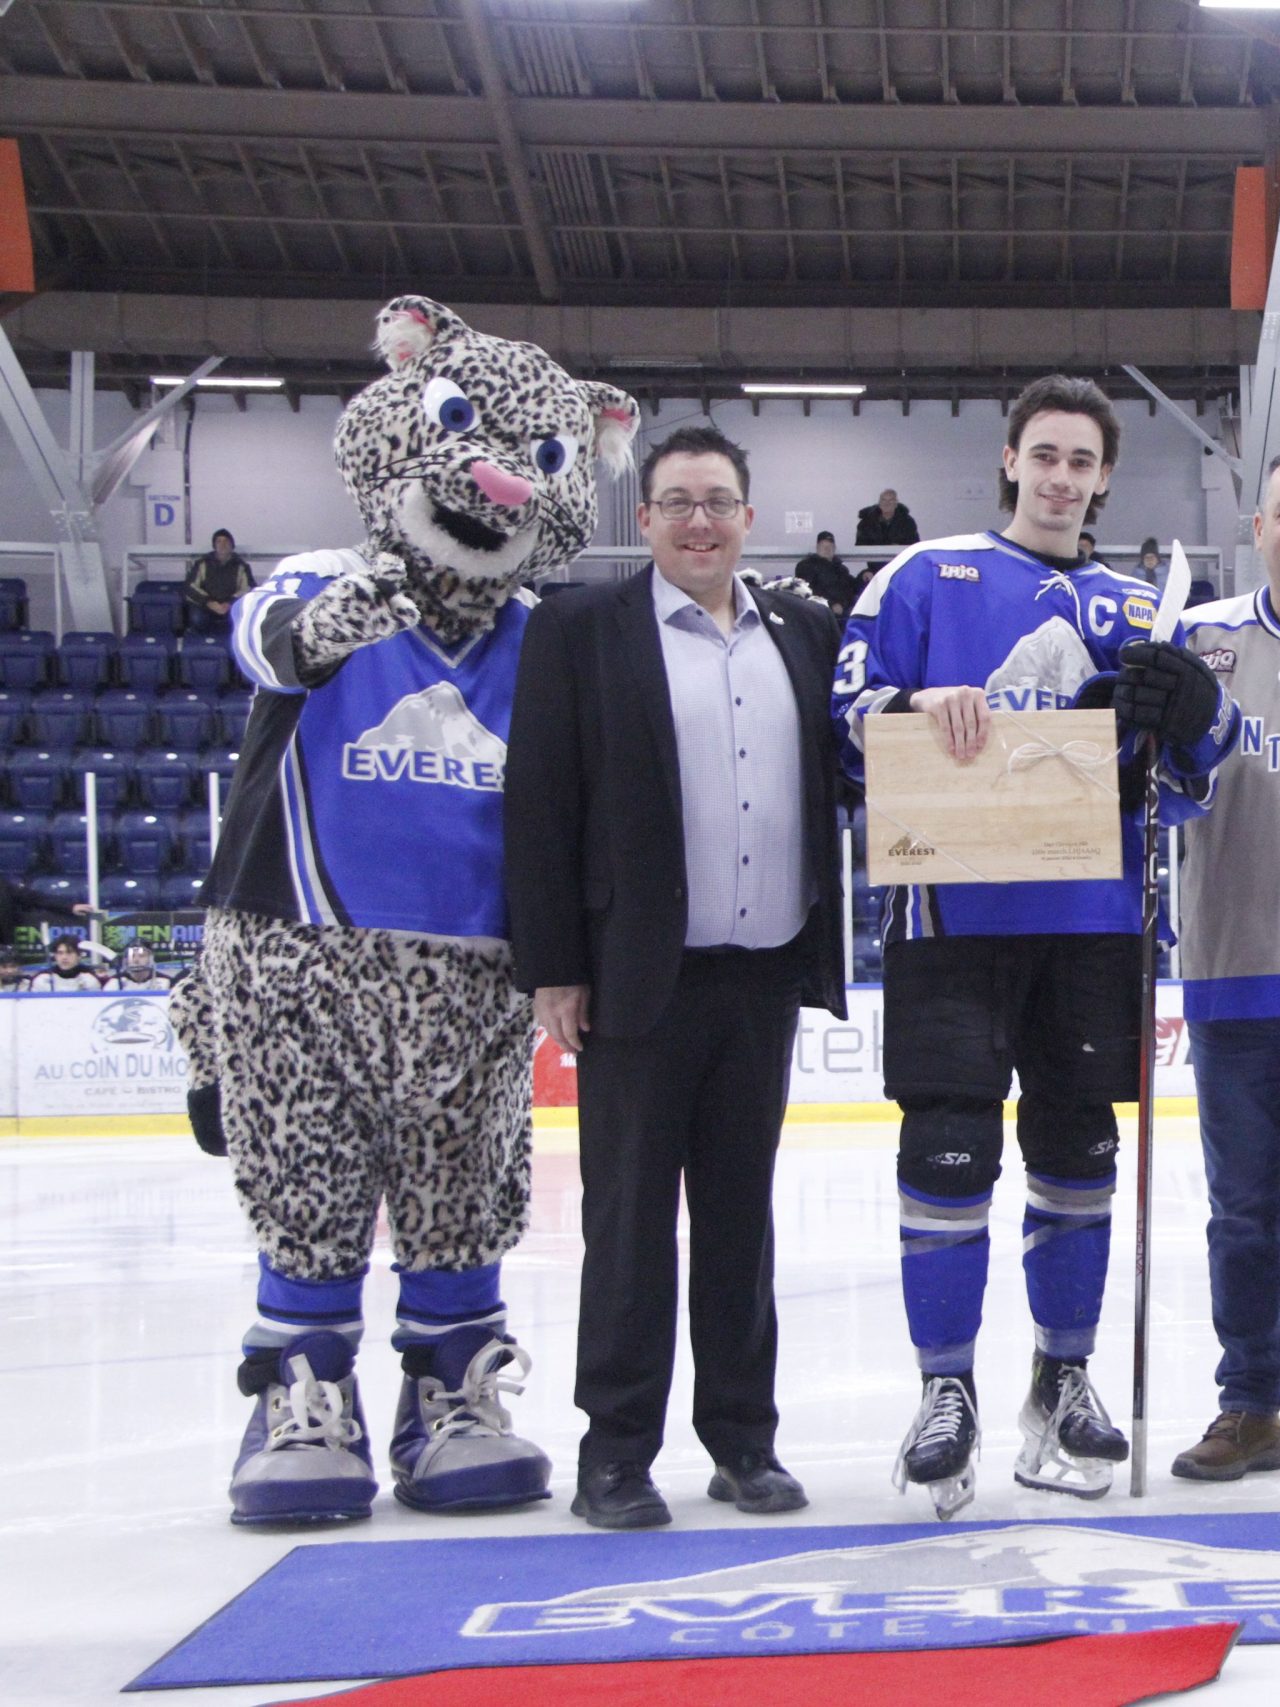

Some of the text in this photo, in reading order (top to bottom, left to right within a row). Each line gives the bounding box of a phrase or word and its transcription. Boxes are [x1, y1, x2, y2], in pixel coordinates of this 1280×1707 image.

[153, 503, 175, 526] D
[1088, 595, 1118, 636] C
[1128, 604, 1153, 621] NAPA
[832, 640, 868, 695] 3
[345, 745, 504, 788] EVERE
[888, 847, 936, 857] EVEREST
[34, 1064, 64, 1080] AU
[70, 1055, 119, 1079] COIN
[125, 1053, 153, 1078] DU
[136, 1085, 182, 1095] BISTRO
